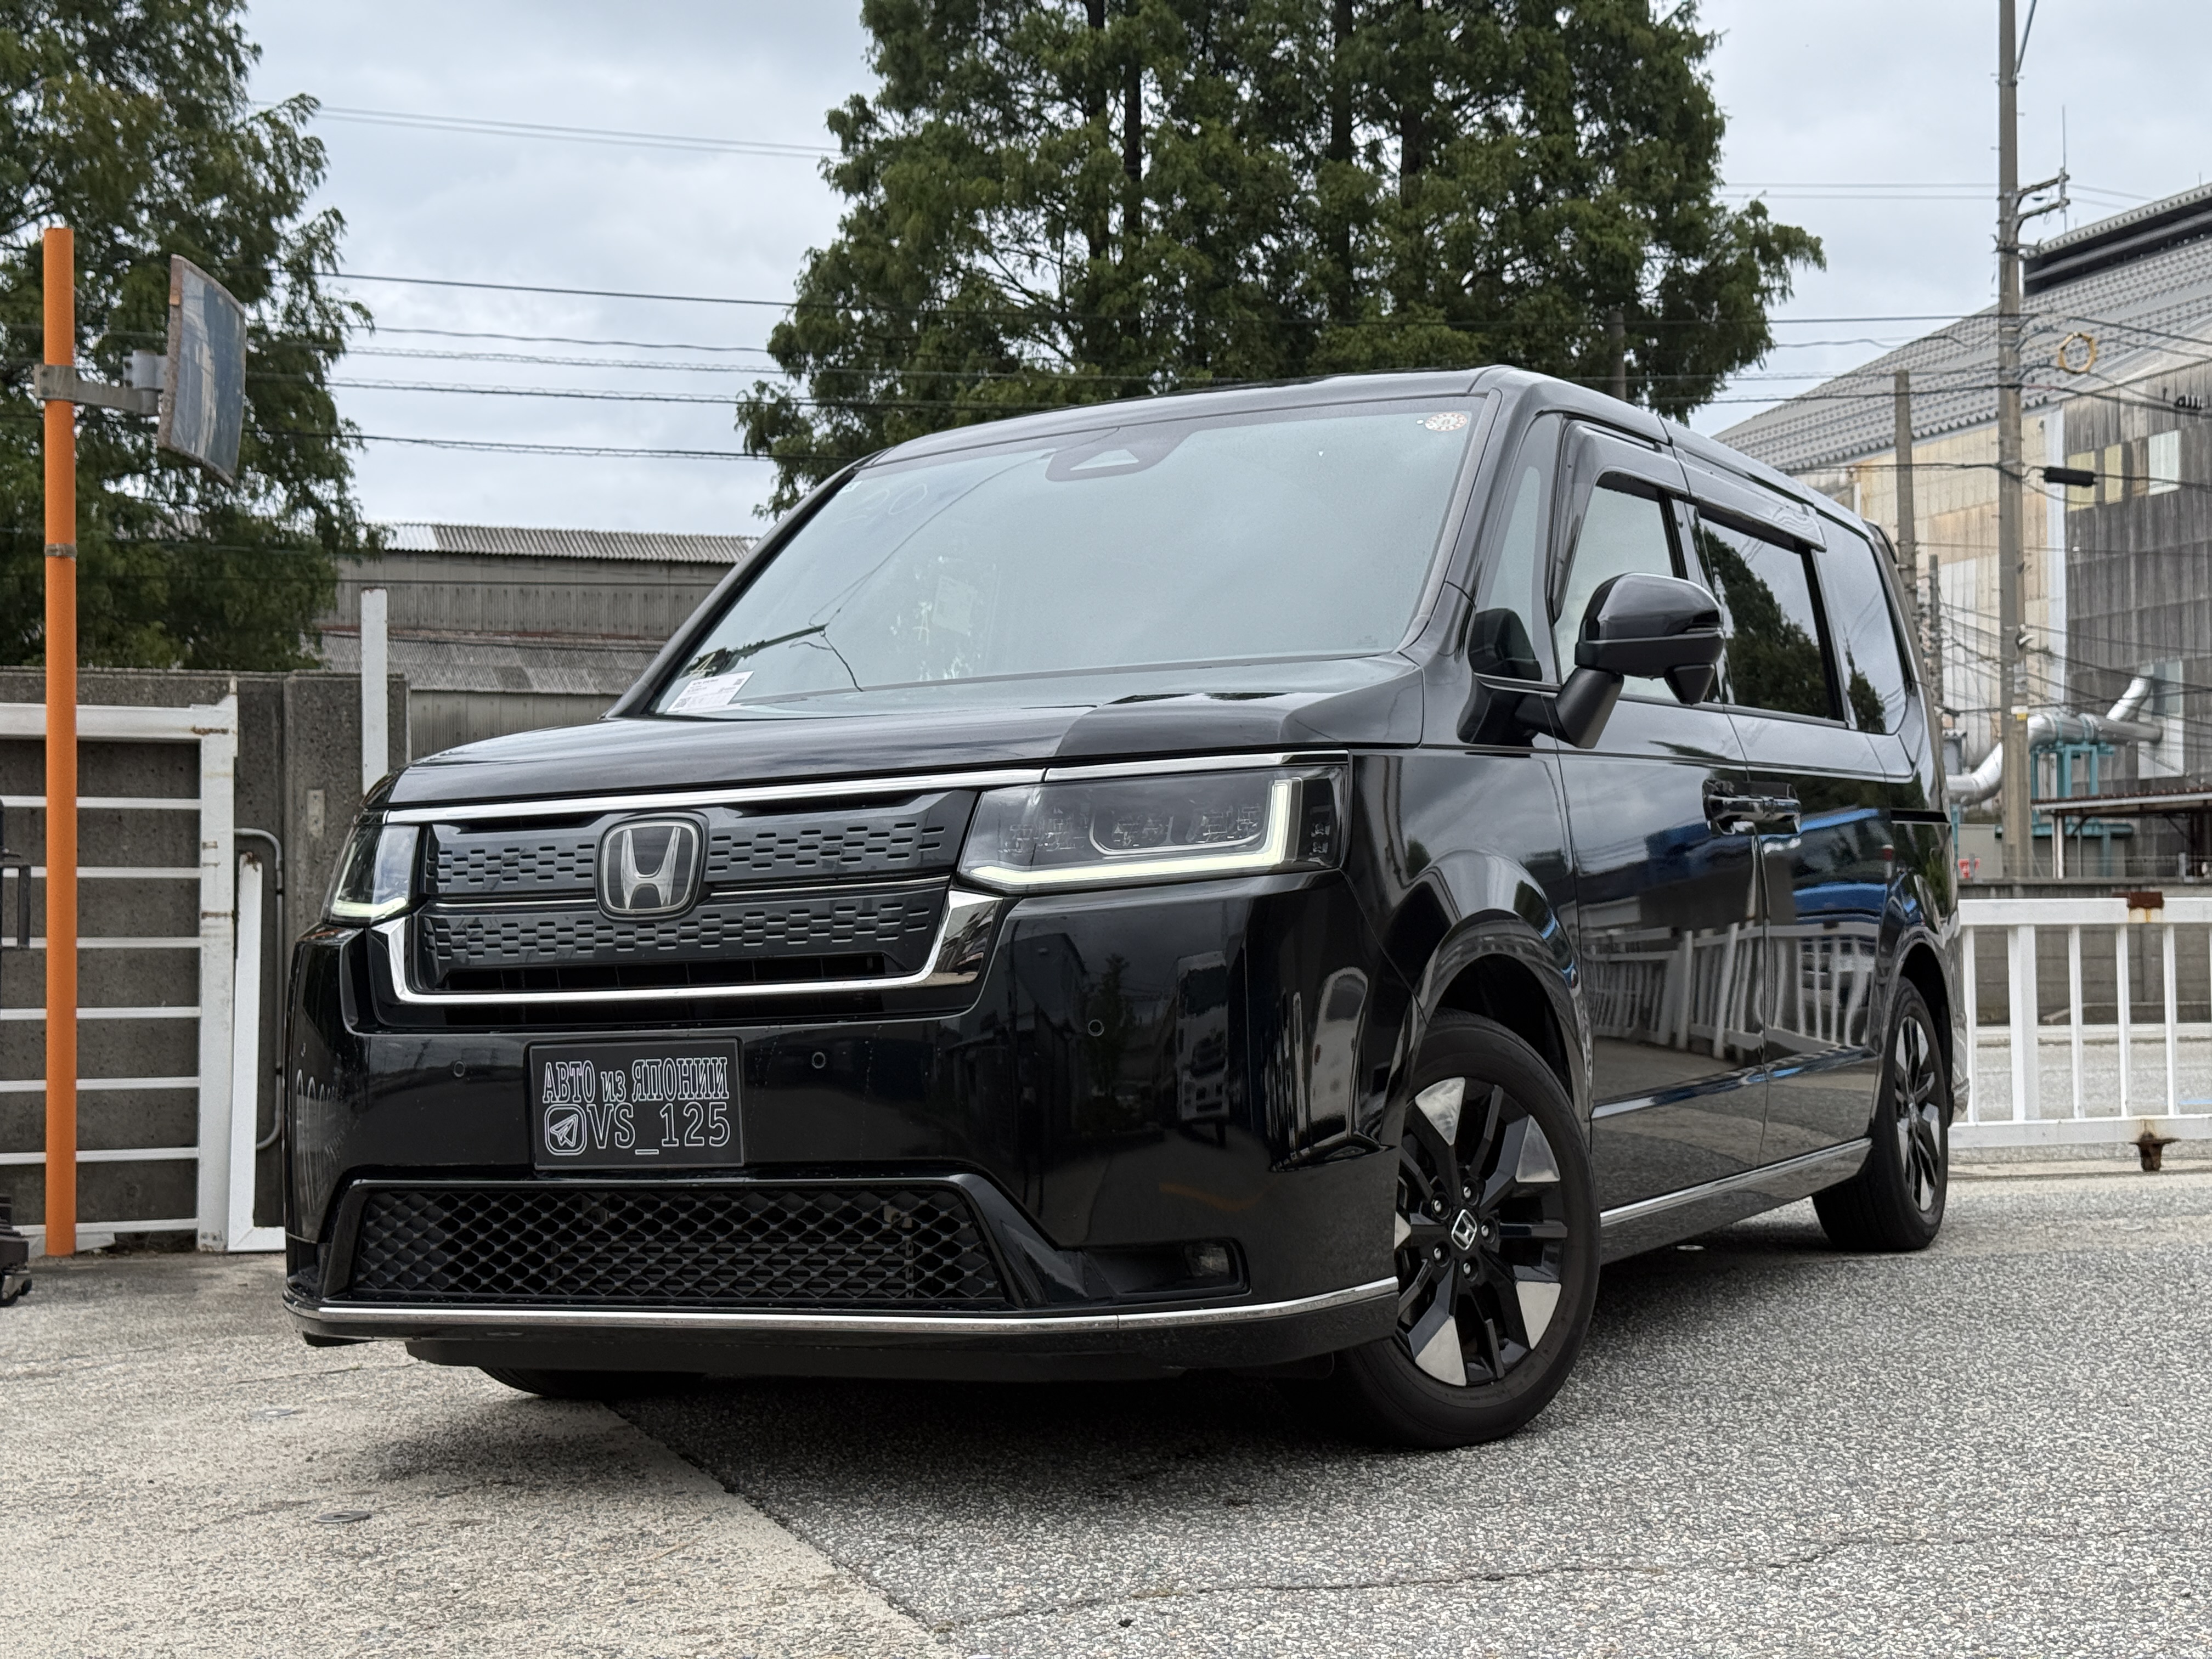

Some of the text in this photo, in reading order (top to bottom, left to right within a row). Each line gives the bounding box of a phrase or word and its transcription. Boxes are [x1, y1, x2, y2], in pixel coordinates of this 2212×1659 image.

[543, 1057, 730, 1104] АВТО из ЯПОНИИ
[586, 1102, 730, 1155] VS_125
